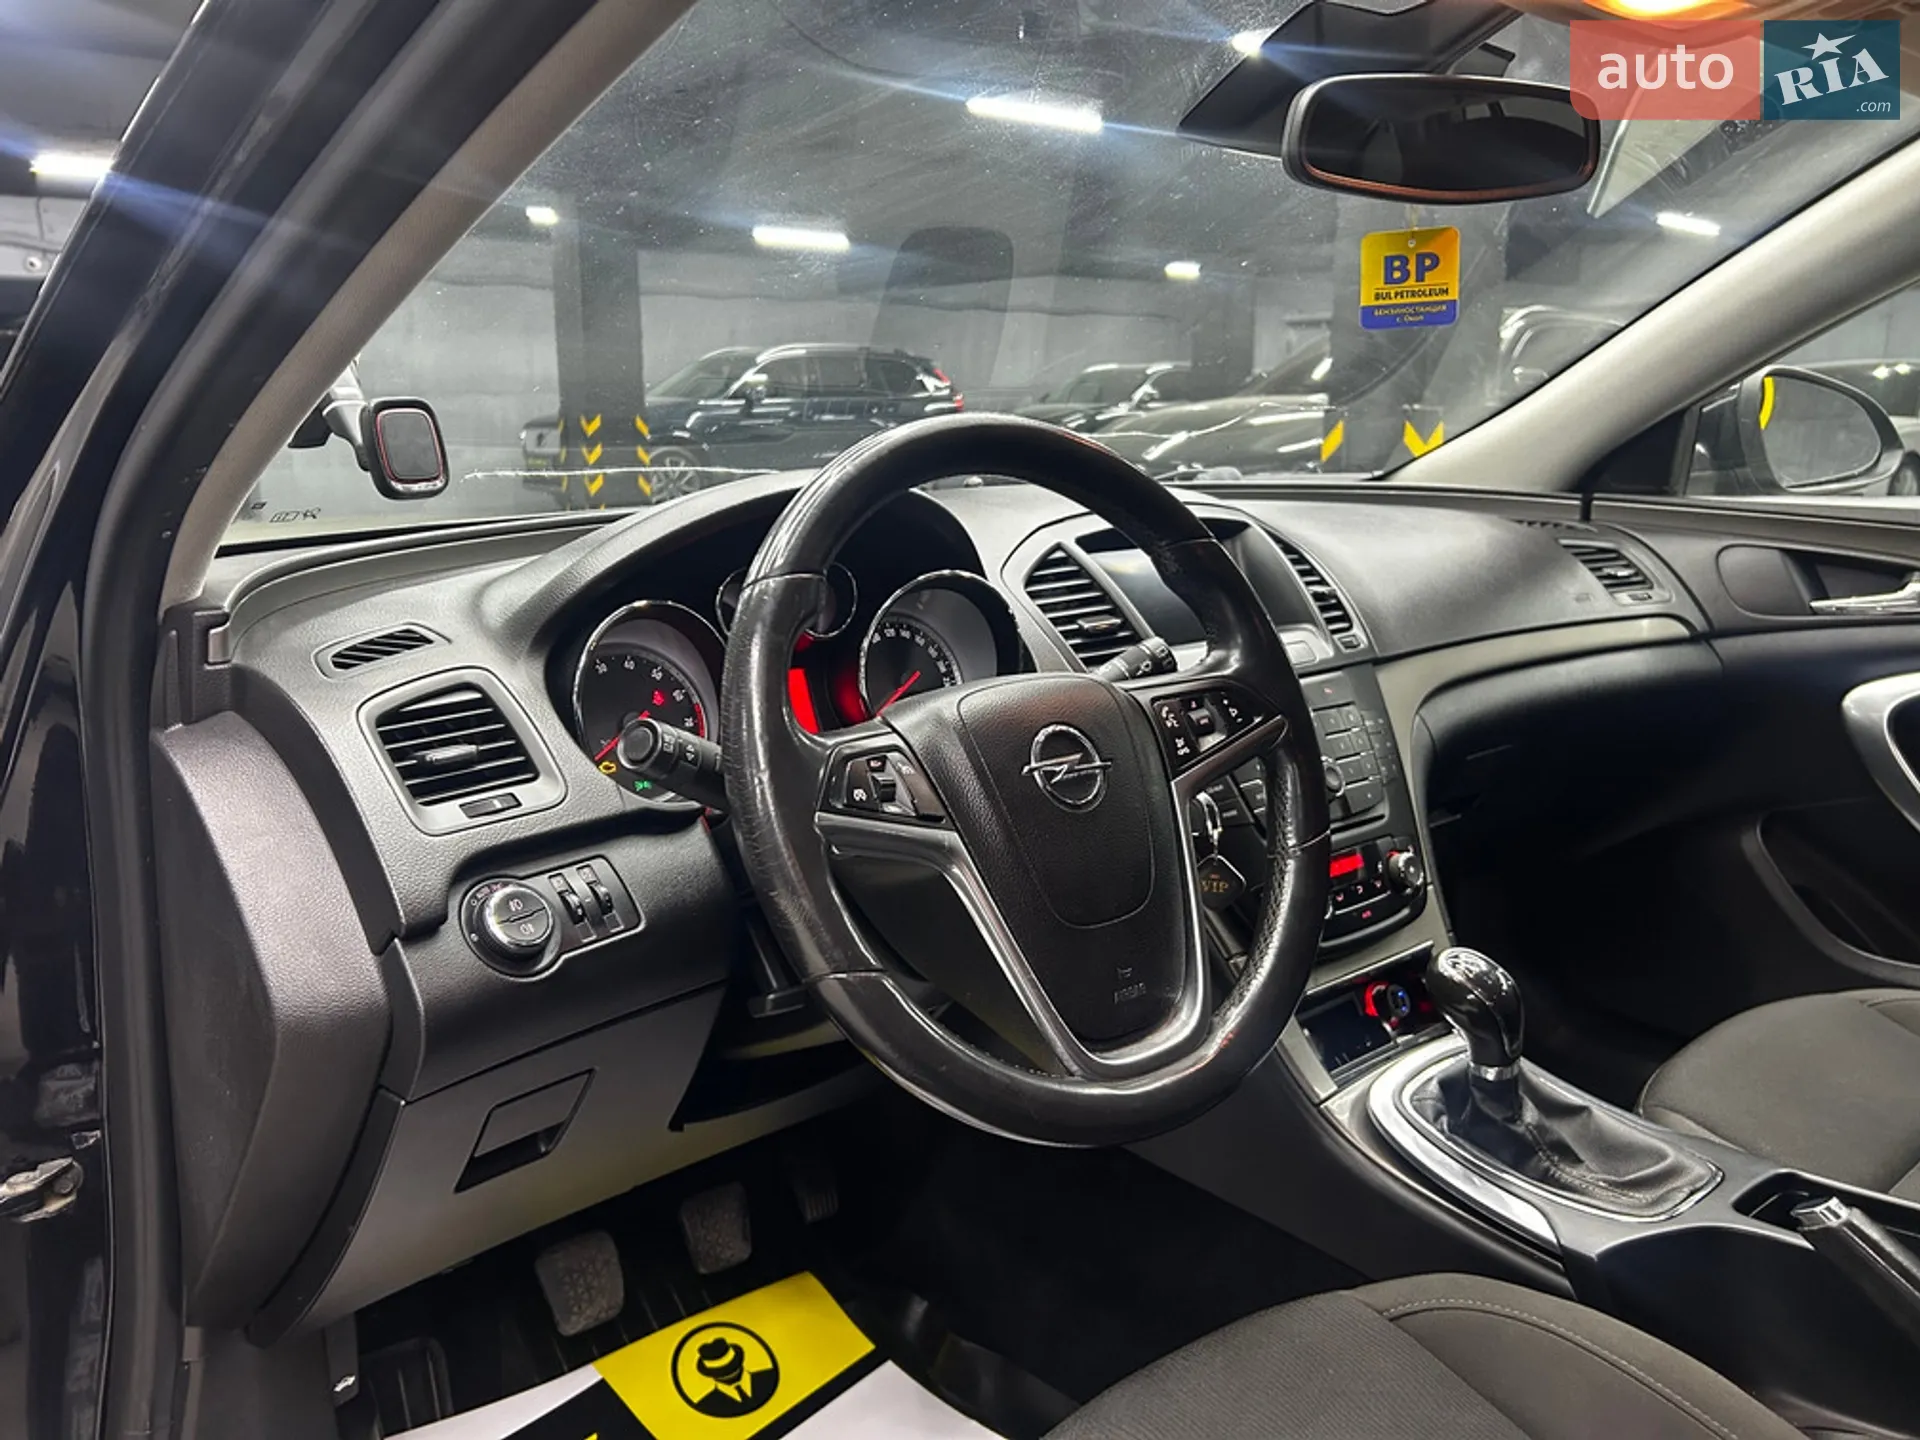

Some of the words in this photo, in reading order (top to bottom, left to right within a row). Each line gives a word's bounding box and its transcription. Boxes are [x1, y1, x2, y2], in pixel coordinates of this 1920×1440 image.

[1383, 252, 1440, 285] BP
[1374, 290, 1393, 301] BUL
[1394, 287, 1449, 299] PETROLEUM
[1201, 880, 1229, 893] VIP
